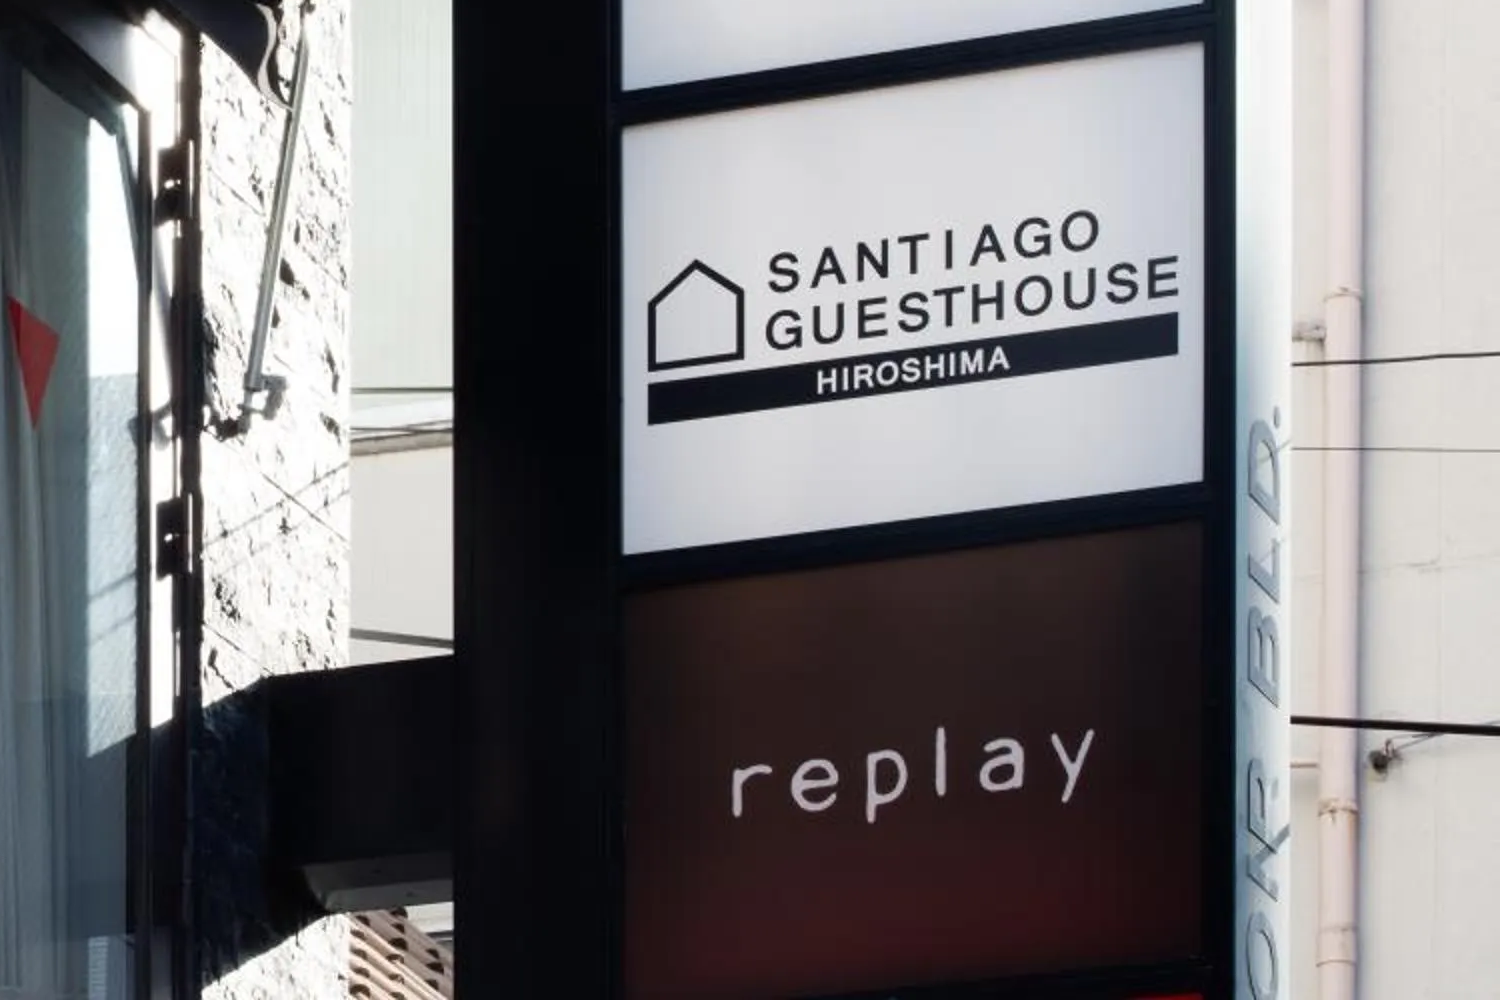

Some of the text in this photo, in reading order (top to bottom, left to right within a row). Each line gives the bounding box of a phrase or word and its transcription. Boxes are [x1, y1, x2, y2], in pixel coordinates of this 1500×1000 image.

[767, 210, 1100, 293] SANTIAGO
[765, 255, 1179, 351] GUESTHOUSE
[817, 345, 1010, 396] HIROSHIMA
[732, 727, 1095, 823] replay
